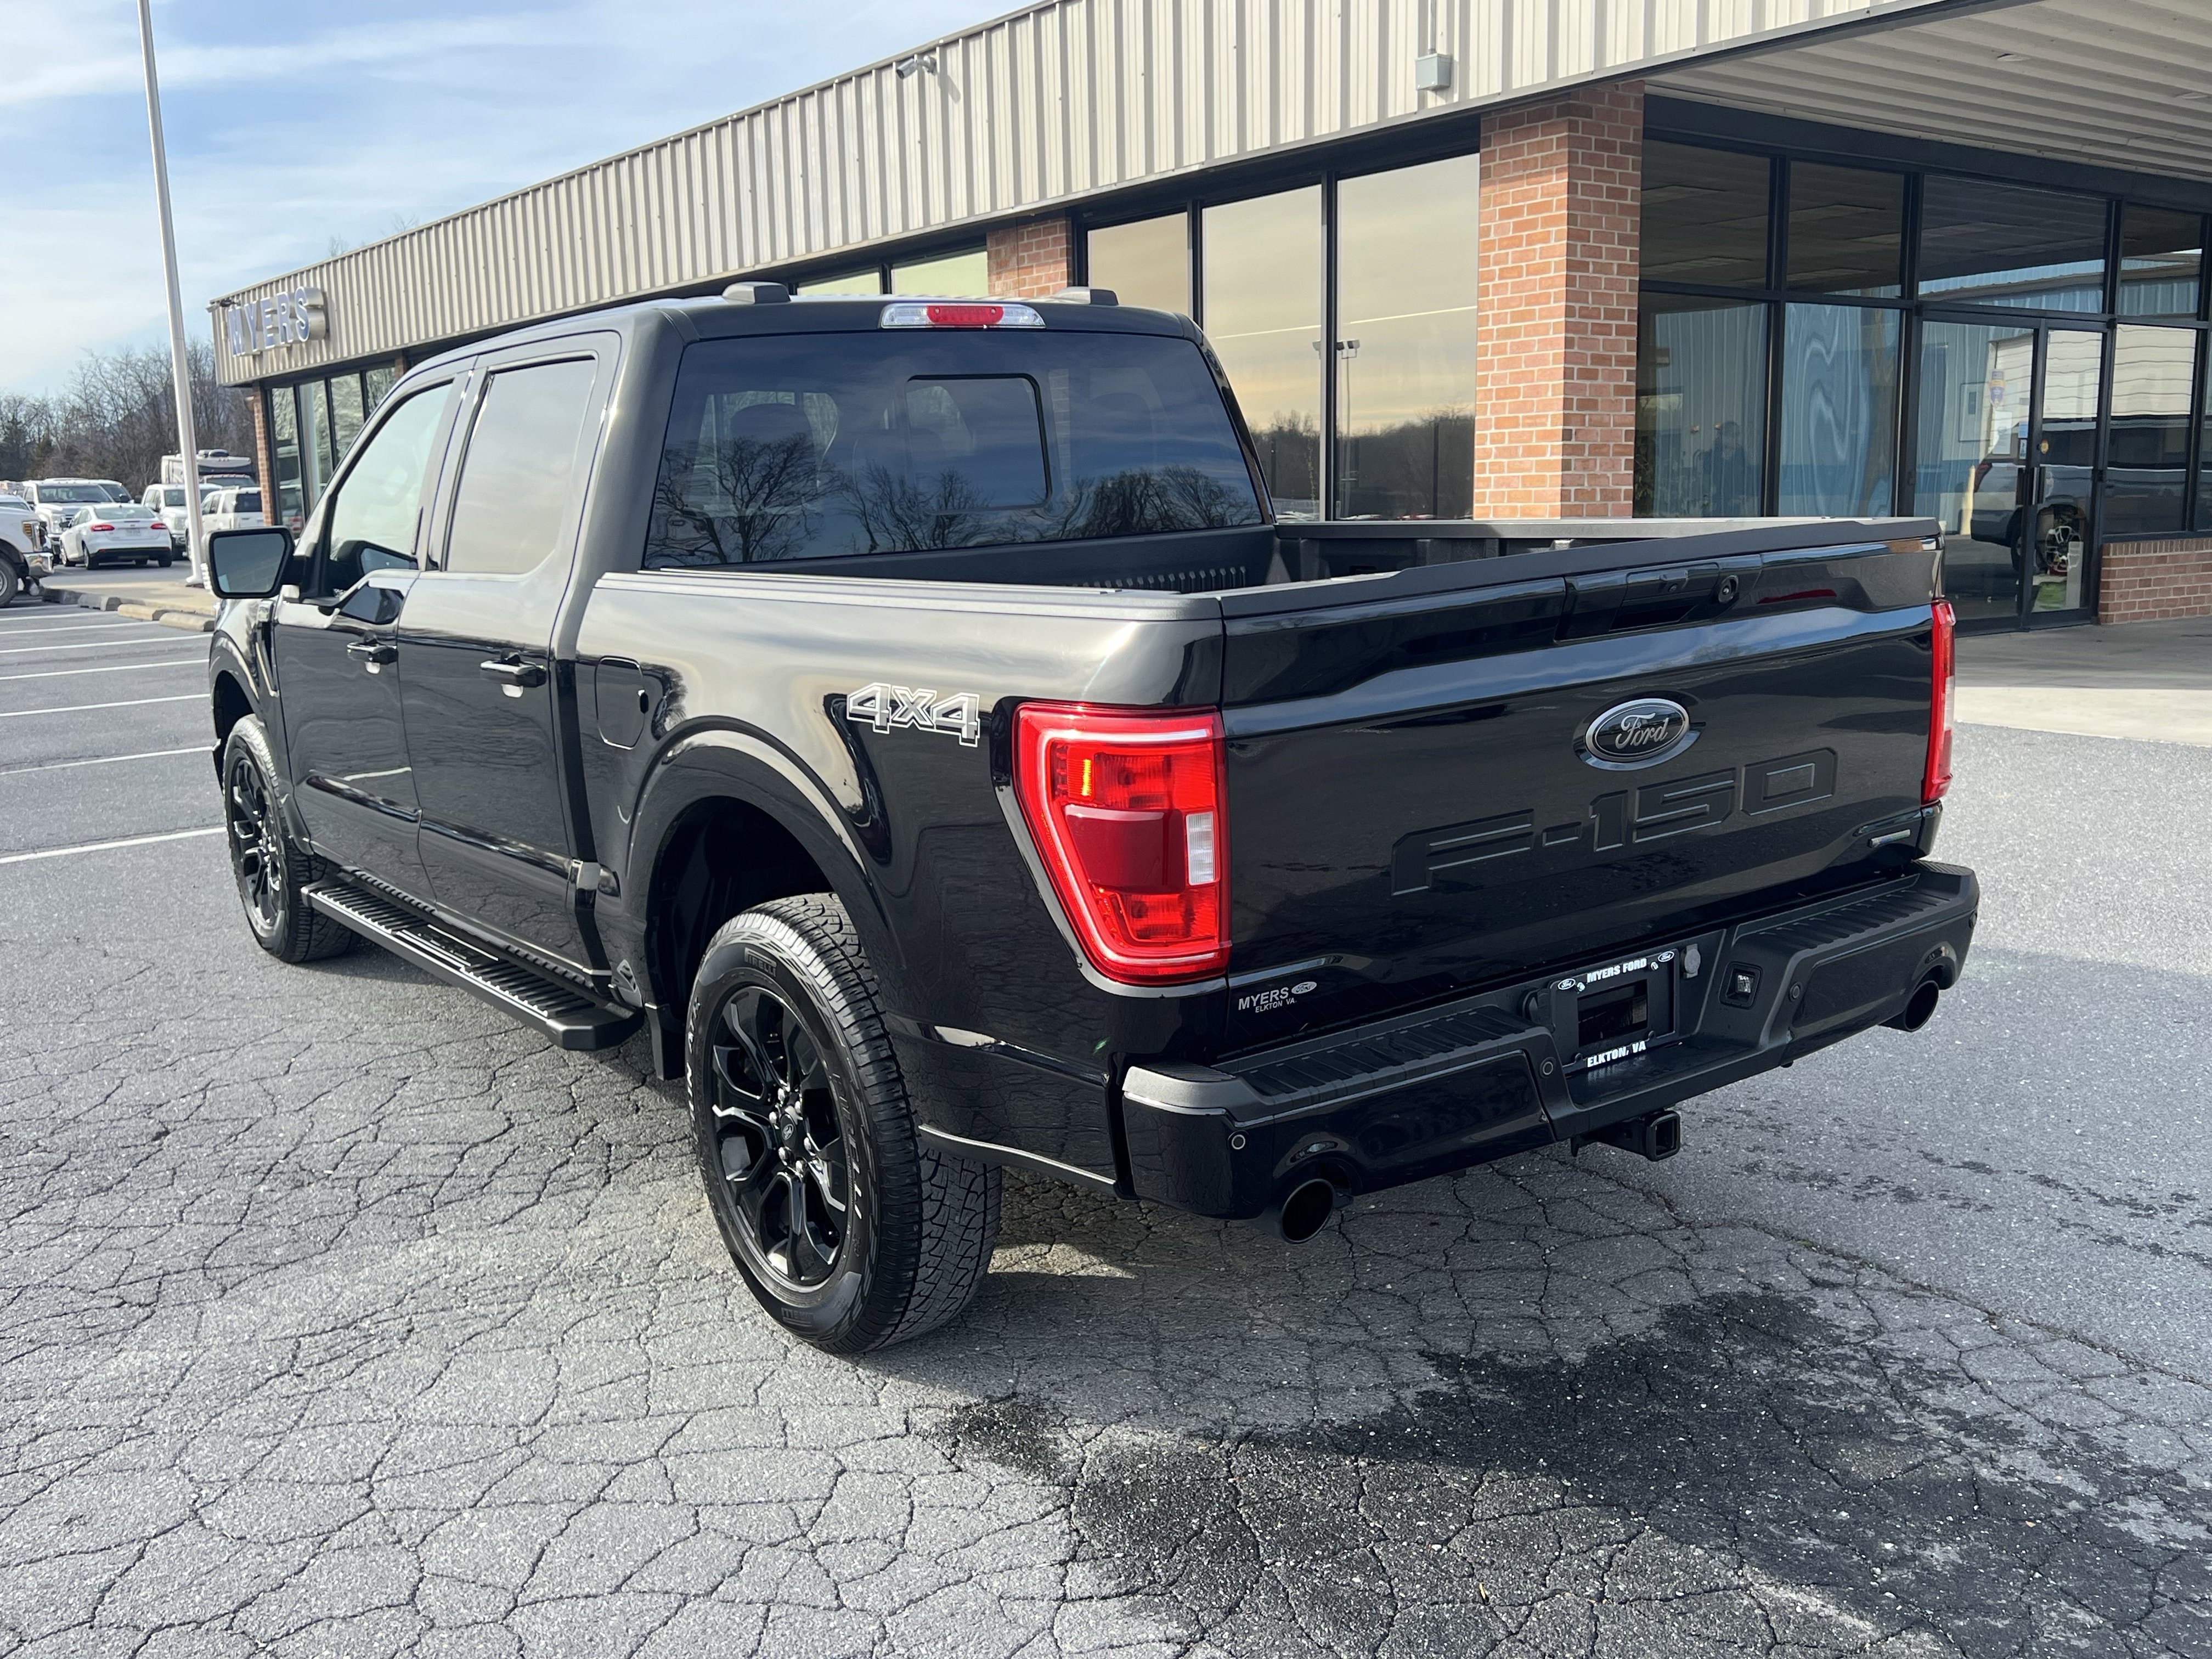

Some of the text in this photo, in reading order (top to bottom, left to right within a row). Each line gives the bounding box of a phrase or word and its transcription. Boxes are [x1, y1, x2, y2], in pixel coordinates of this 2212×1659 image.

[227, 286, 311, 357] MYERS
[1615, 712, 1669, 749] Ford
[1391, 747, 1838, 896] F-150
[744, 947, 777, 977] PIRELLI
[1587, 957, 1647, 983] MYERS FORD
[1238, 986, 1289, 1011] MYERS
[1255, 1000, 1283, 1013] ELKTON
[1587, 1040, 1646, 1068] ELKTON, VA
